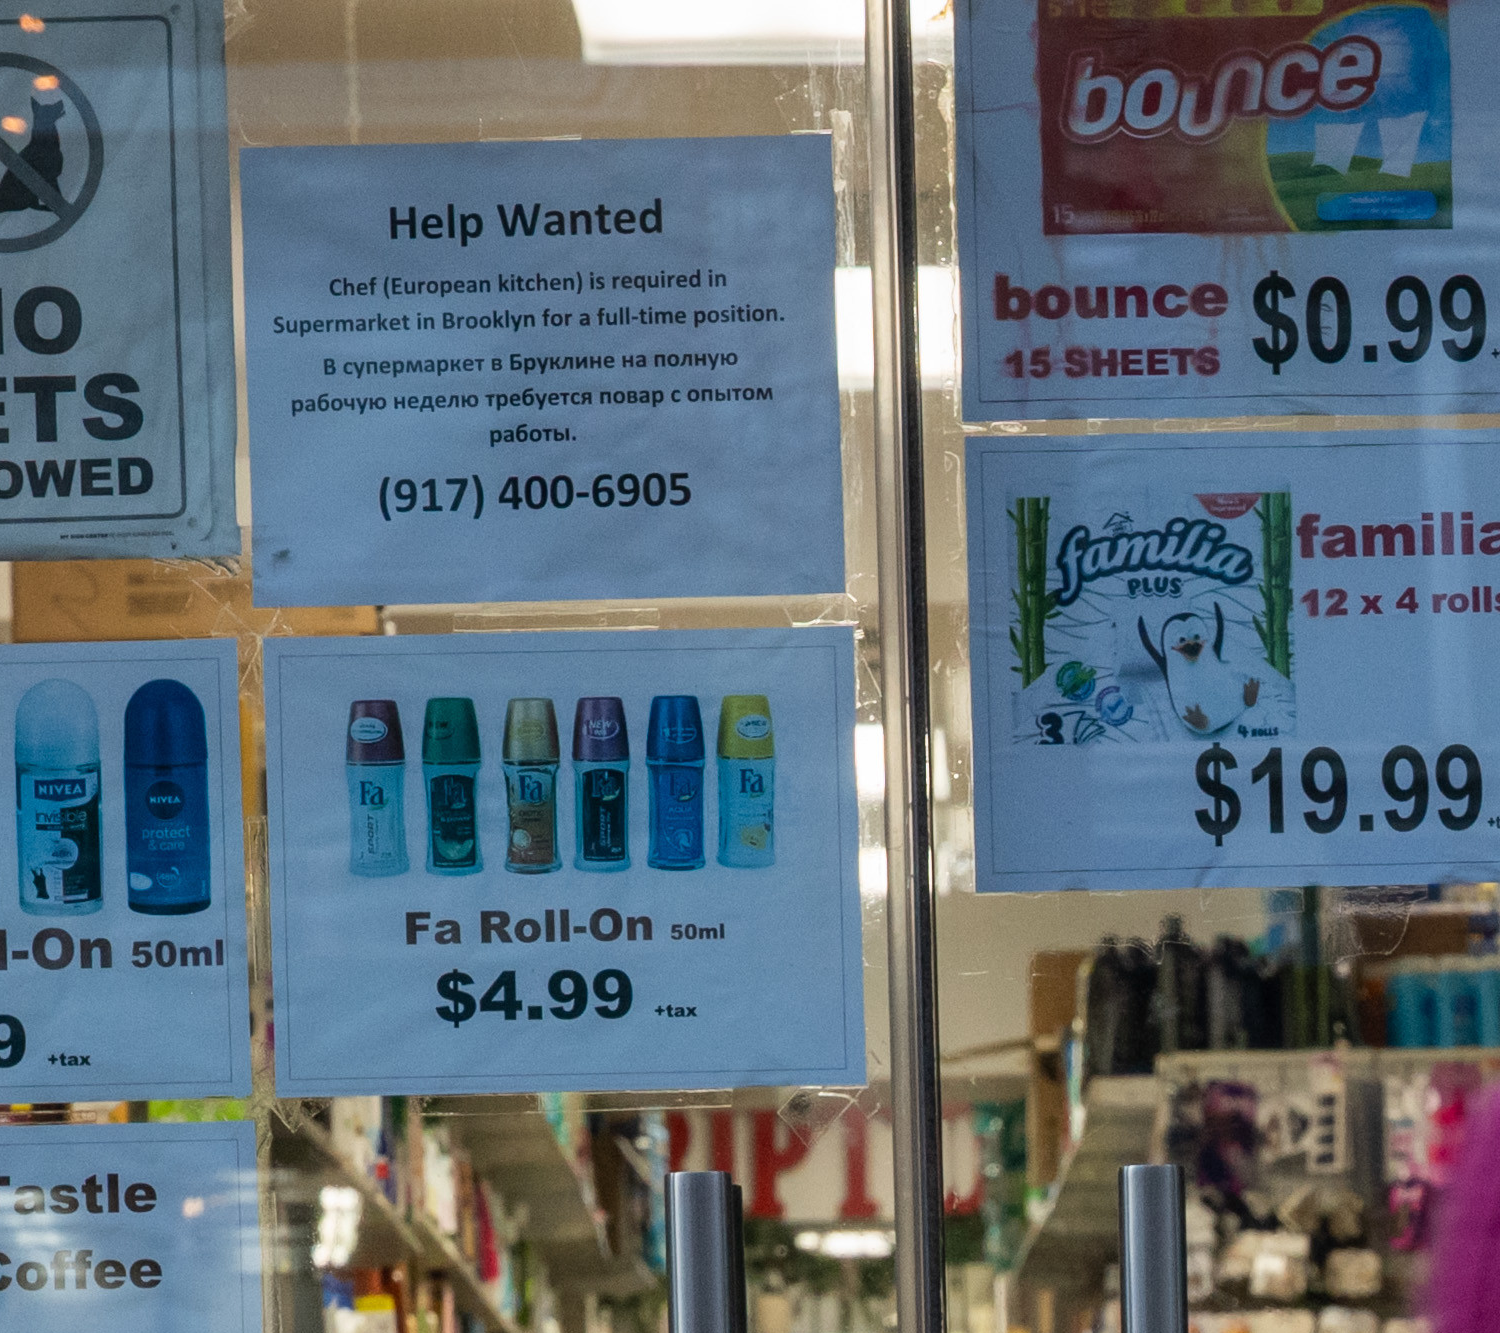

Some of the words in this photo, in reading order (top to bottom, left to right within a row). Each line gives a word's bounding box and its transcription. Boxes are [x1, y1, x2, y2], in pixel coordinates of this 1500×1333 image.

[1068, 38, 1377, 137] bounce
[389, 204, 484, 247] Help
[497, 199, 664, 237] Wanted
[329, 275, 377, 298] Chef
[383, 275, 492, 299] (European
[498, 271, 584, 295] kitchen)
[590, 271, 605, 291] is
[611, 268, 701, 294] required
[708, 268, 727, 288] in
[273, 311, 410, 337] Supermarket
[416, 309, 435, 331] in
[441, 307, 536, 333] Brooklyn
[542, 306, 571, 328] for
[580, 310, 591, 326] a
[597, 304, 686, 327] full-time
[693, 303, 785, 327] position.
[993, 273, 1229, 320] bounce
[1252, 271, 1486, 375] $0.99
[324, 358, 337, 376] В
[343, 355, 484, 381] супермаркет
[491, 357, 502, 372] в
[508, 352, 614, 377] Бруклине
[621, 352, 648, 369] на
[654, 349, 738, 372] полную
[1005, 348, 1051, 379] 15
[1064, 346, 1221, 377] SHEETS
[291, 392, 386, 417] рабочую
[394, 391, 479, 414] неделю
[486, 388, 593, 415] требуется
[600, 386, 664, 411] повар
[671, 388, 681, 403] с
[687, 385, 774, 407] опытом
[489, 421, 578, 448] работы.
[378, 476, 485, 520] (917)
[497, 472, 692, 510] 400-6905
[1127, 576, 1181, 597] PLUS
[1300, 589, 1348, 618] 12
[1359, 590, 1383, 615] x
[1395, 587, 1418, 614] 4
[360, 781, 384, 806] Fa
[1194, 743, 1483, 847] $19.99
[142, 827, 190, 840] protect
[405, 912, 461, 945] Fa
[481, 909, 653, 943] Roll-On
[671, 923, 725, 941] 50ml
[132, 940, 224, 968] 50ml
[436, 970, 633, 1028] $4.99
[654, 1004, 697, 1018] +tax
[47, 1053, 91, 1067] +tax
